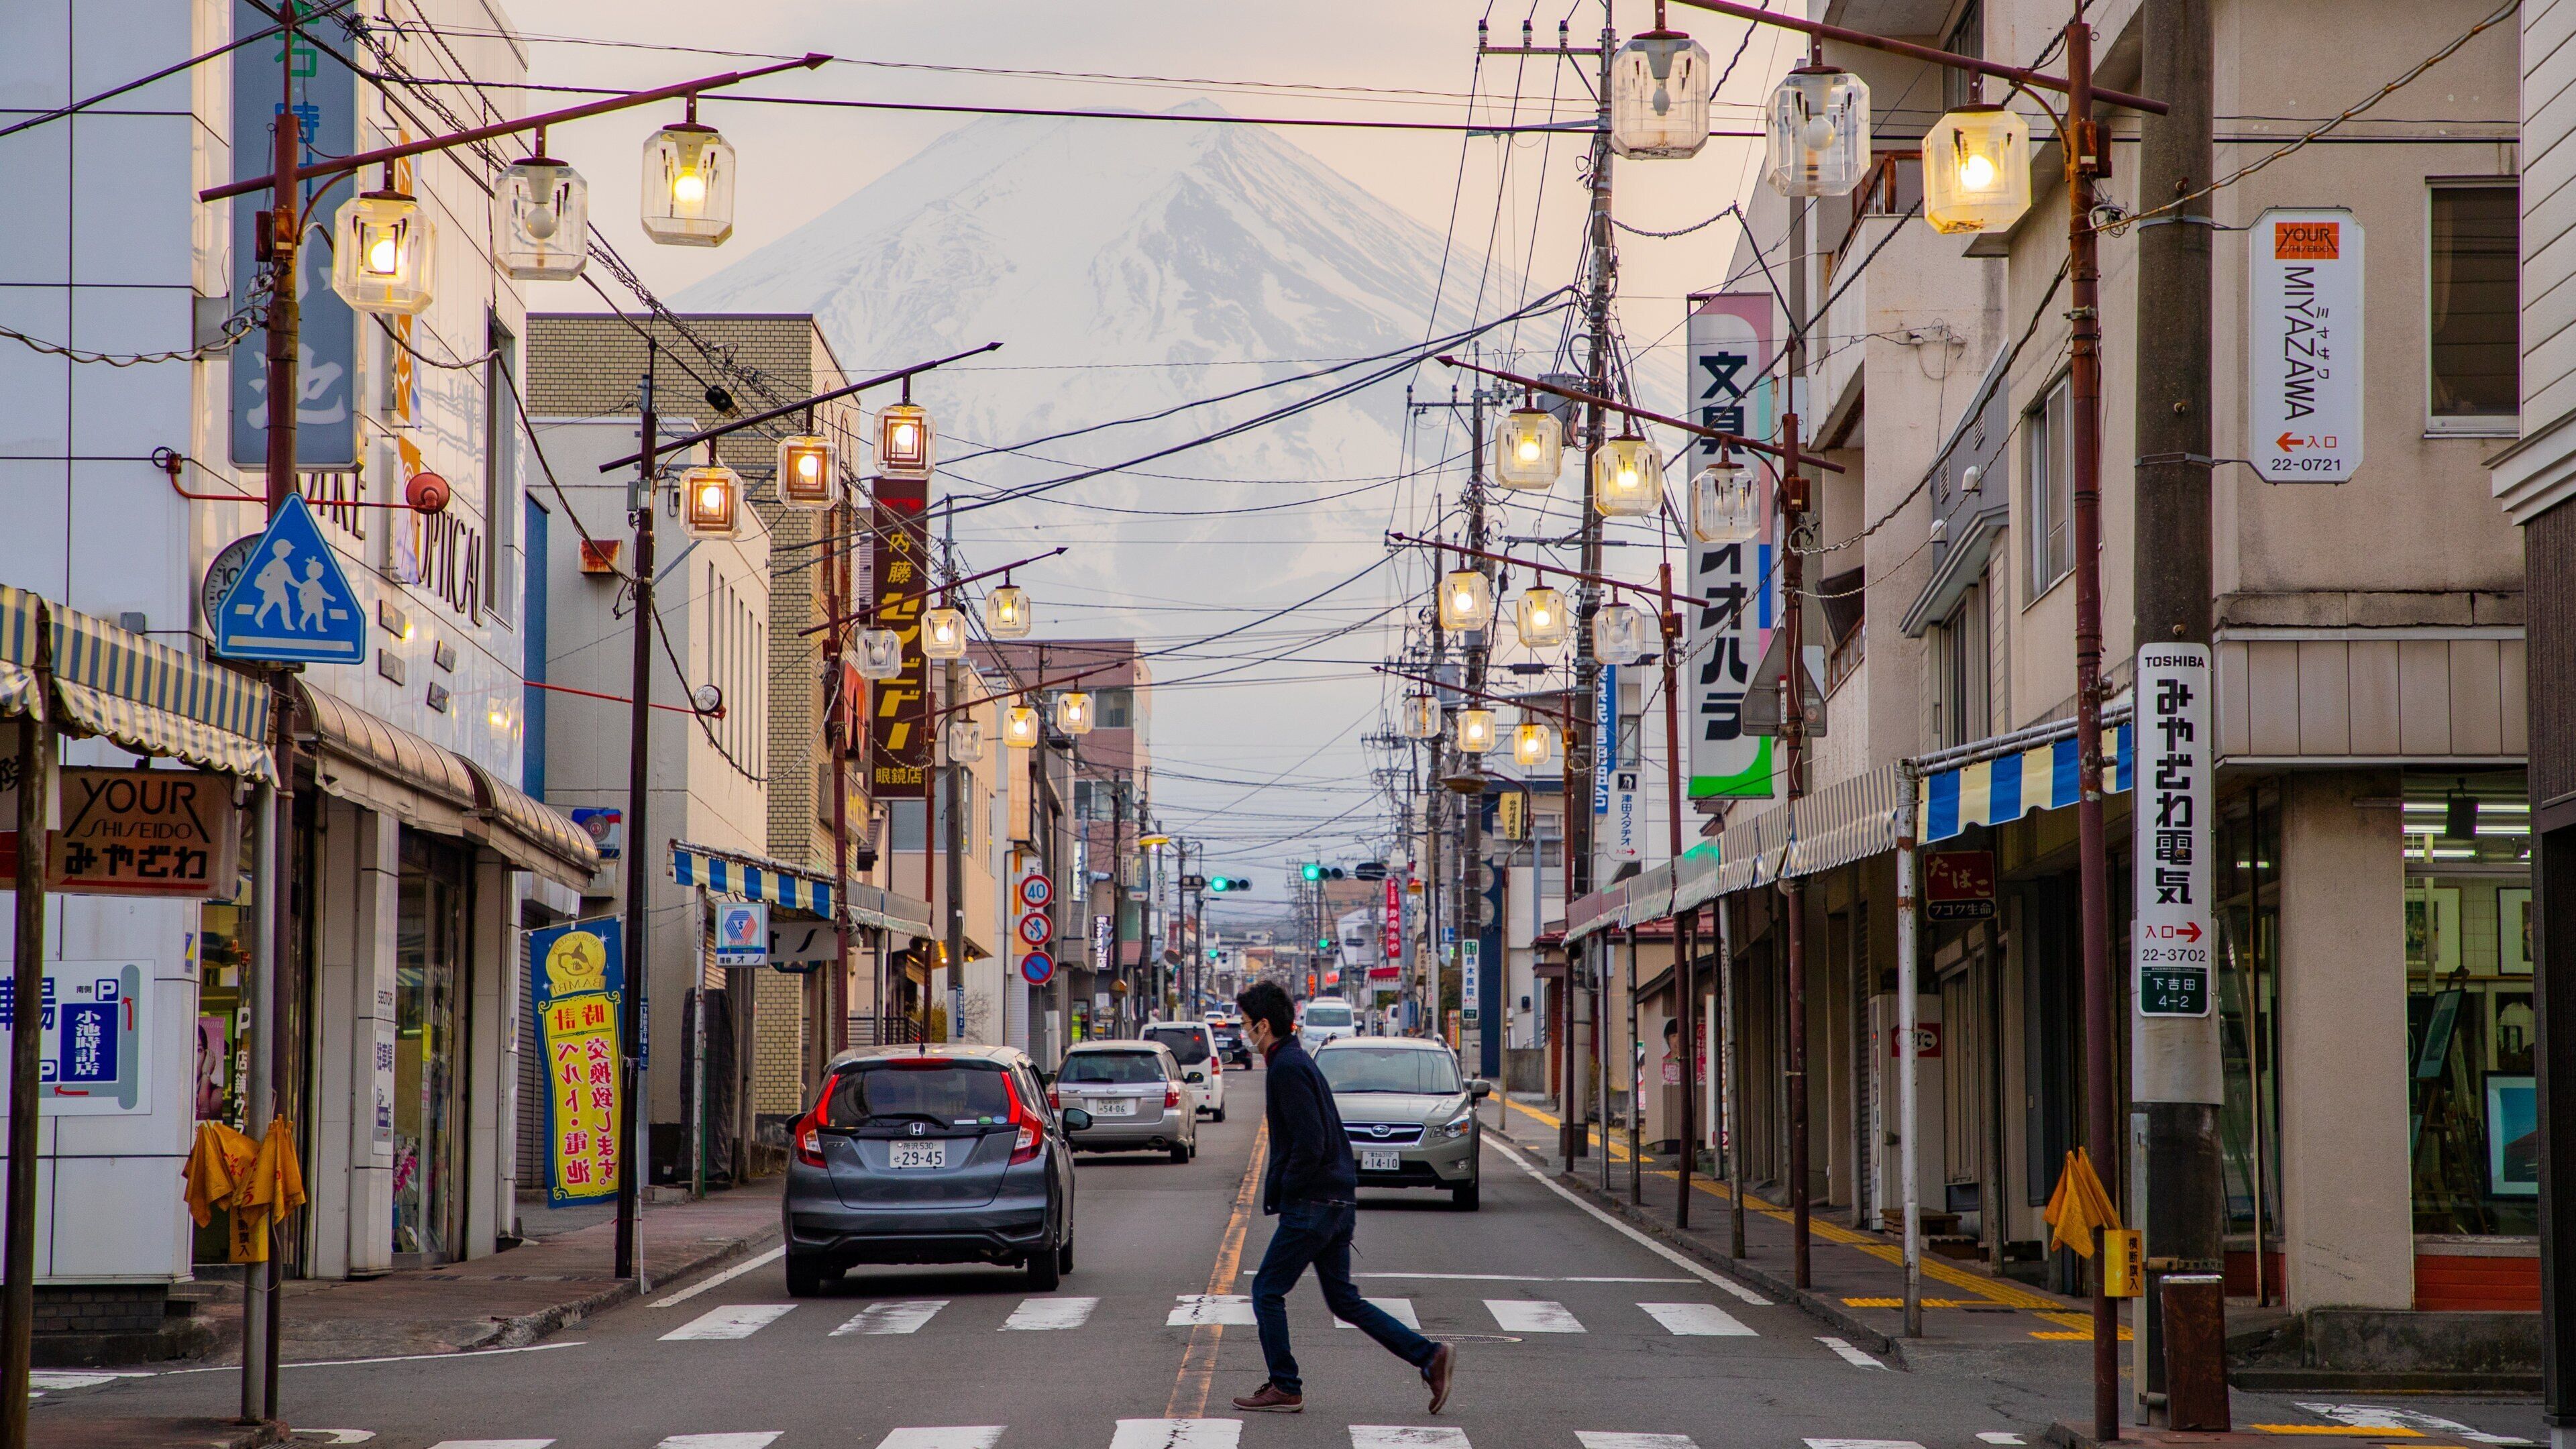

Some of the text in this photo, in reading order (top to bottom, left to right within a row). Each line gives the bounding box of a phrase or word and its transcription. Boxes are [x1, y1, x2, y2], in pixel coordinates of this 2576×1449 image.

[2277, 228, 2337, 252] YOUR
[2285, 267, 2314, 421] MIYAZAWA
[2316, 307, 2330, 379] ミヤザワ
[2306, 435, 2337, 448] 入口
[2271, 458, 2341, 471] 22-0721
[888, 533, 912, 584] 内藤
[2145, 656, 2204, 667] TOSHIBA
[875, 769, 922, 785] 眼鏡店
[2155, 678, 2194, 905] みやざわ電気
[63, 778, 211, 843] YOUR
[80, 819, 193, 839] SHISEIDO
[65, 842, 207, 879] みやざわ
[1930, 856, 1991, 896] たばこ
[1028, 883, 1046, 899] 40
[1932, 903, 1992, 916] フコク生命
[2145, 926, 2174, 938] 入口
[2143, 949, 2206, 962] 22-3702
[76, 981, 116, 1000] 南側 P
[2153, 978, 2196, 991] 下吉田
[2159, 995, 2189, 1008] 4-2
[74, 1010, 101, 1076] 小池時計店
[643, 1046, 647, 1054] 2
[1104, 1105, 1125, 1113] 54-06
[902, 1152, 943, 1166] 29-45
[1371, 1159, 1397, 1169] 14-10
